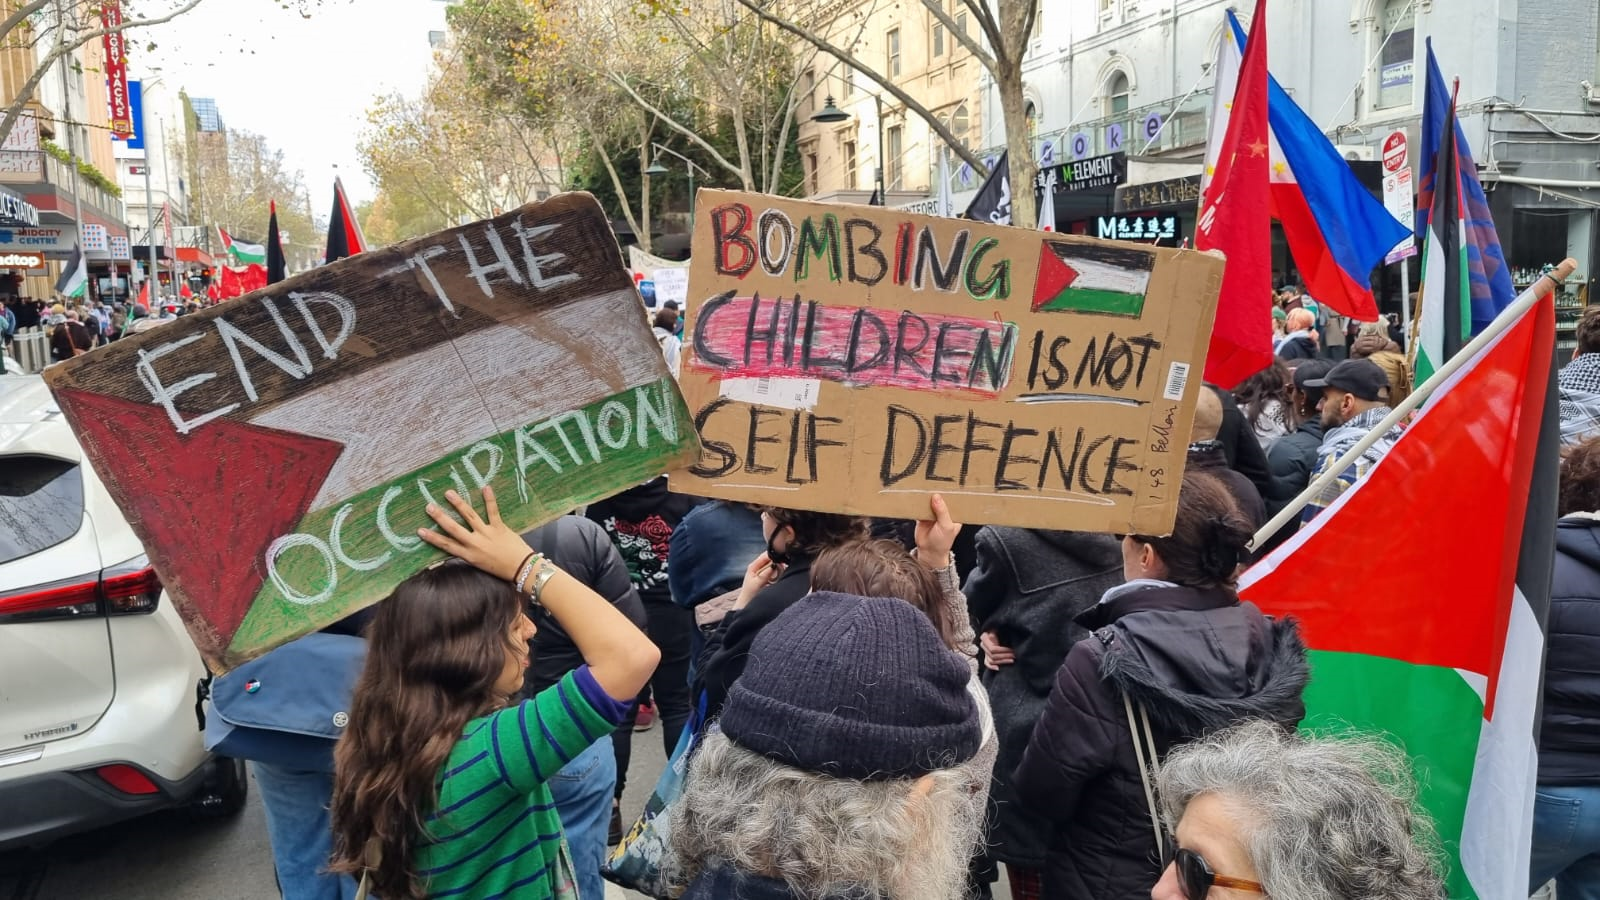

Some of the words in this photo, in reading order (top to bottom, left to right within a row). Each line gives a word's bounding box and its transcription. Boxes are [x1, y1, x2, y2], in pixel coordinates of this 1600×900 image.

[112, 70, 124, 117] JACK'S
[1386, 153, 1404, 168] ENTRY
[1391, 138, 1399, 149] NO
[1062, 156, 1113, 183] M-ELEMENT
[13, 197, 39, 228] STATION
[1098, 216, 1117, 240] M
[710, 202, 1011, 301] BOMBING
[136, 291, 356, 434] END
[376, 215, 582, 320] THE
[693, 289, 1018, 391] CHILDREN
[1027, 330, 1071, 391] IS
[1073, 331, 1161, 391] NOT
[689, 396, 847, 485] SELF
[880, 404, 1143, 497] DEFENCE
[264, 378, 679, 605] OCCUPATION
